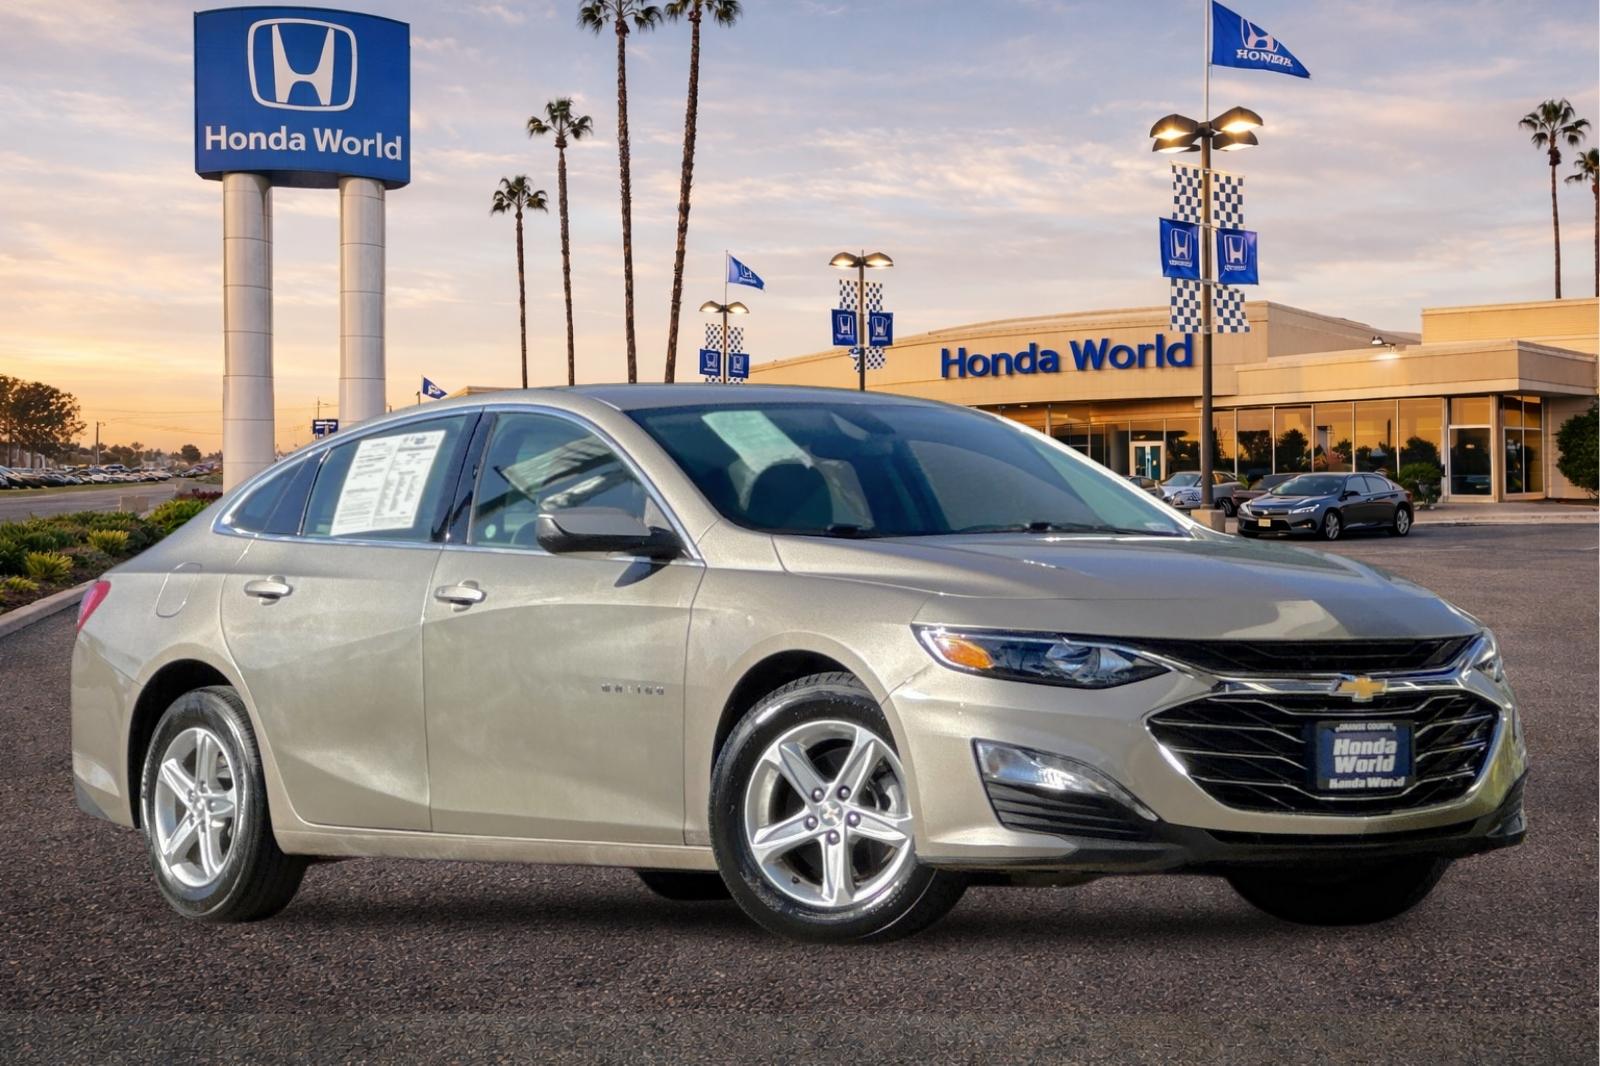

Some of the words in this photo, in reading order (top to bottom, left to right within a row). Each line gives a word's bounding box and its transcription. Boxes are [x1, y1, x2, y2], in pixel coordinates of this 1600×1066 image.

[205, 125, 306, 151] Honda
[313, 128, 402, 161] World
[941, 342, 1060, 378] Honda
[1070, 333, 1194, 371] World
[1333, 737, 1397, 755] Honda
[1334, 755, 1396, 773] World
